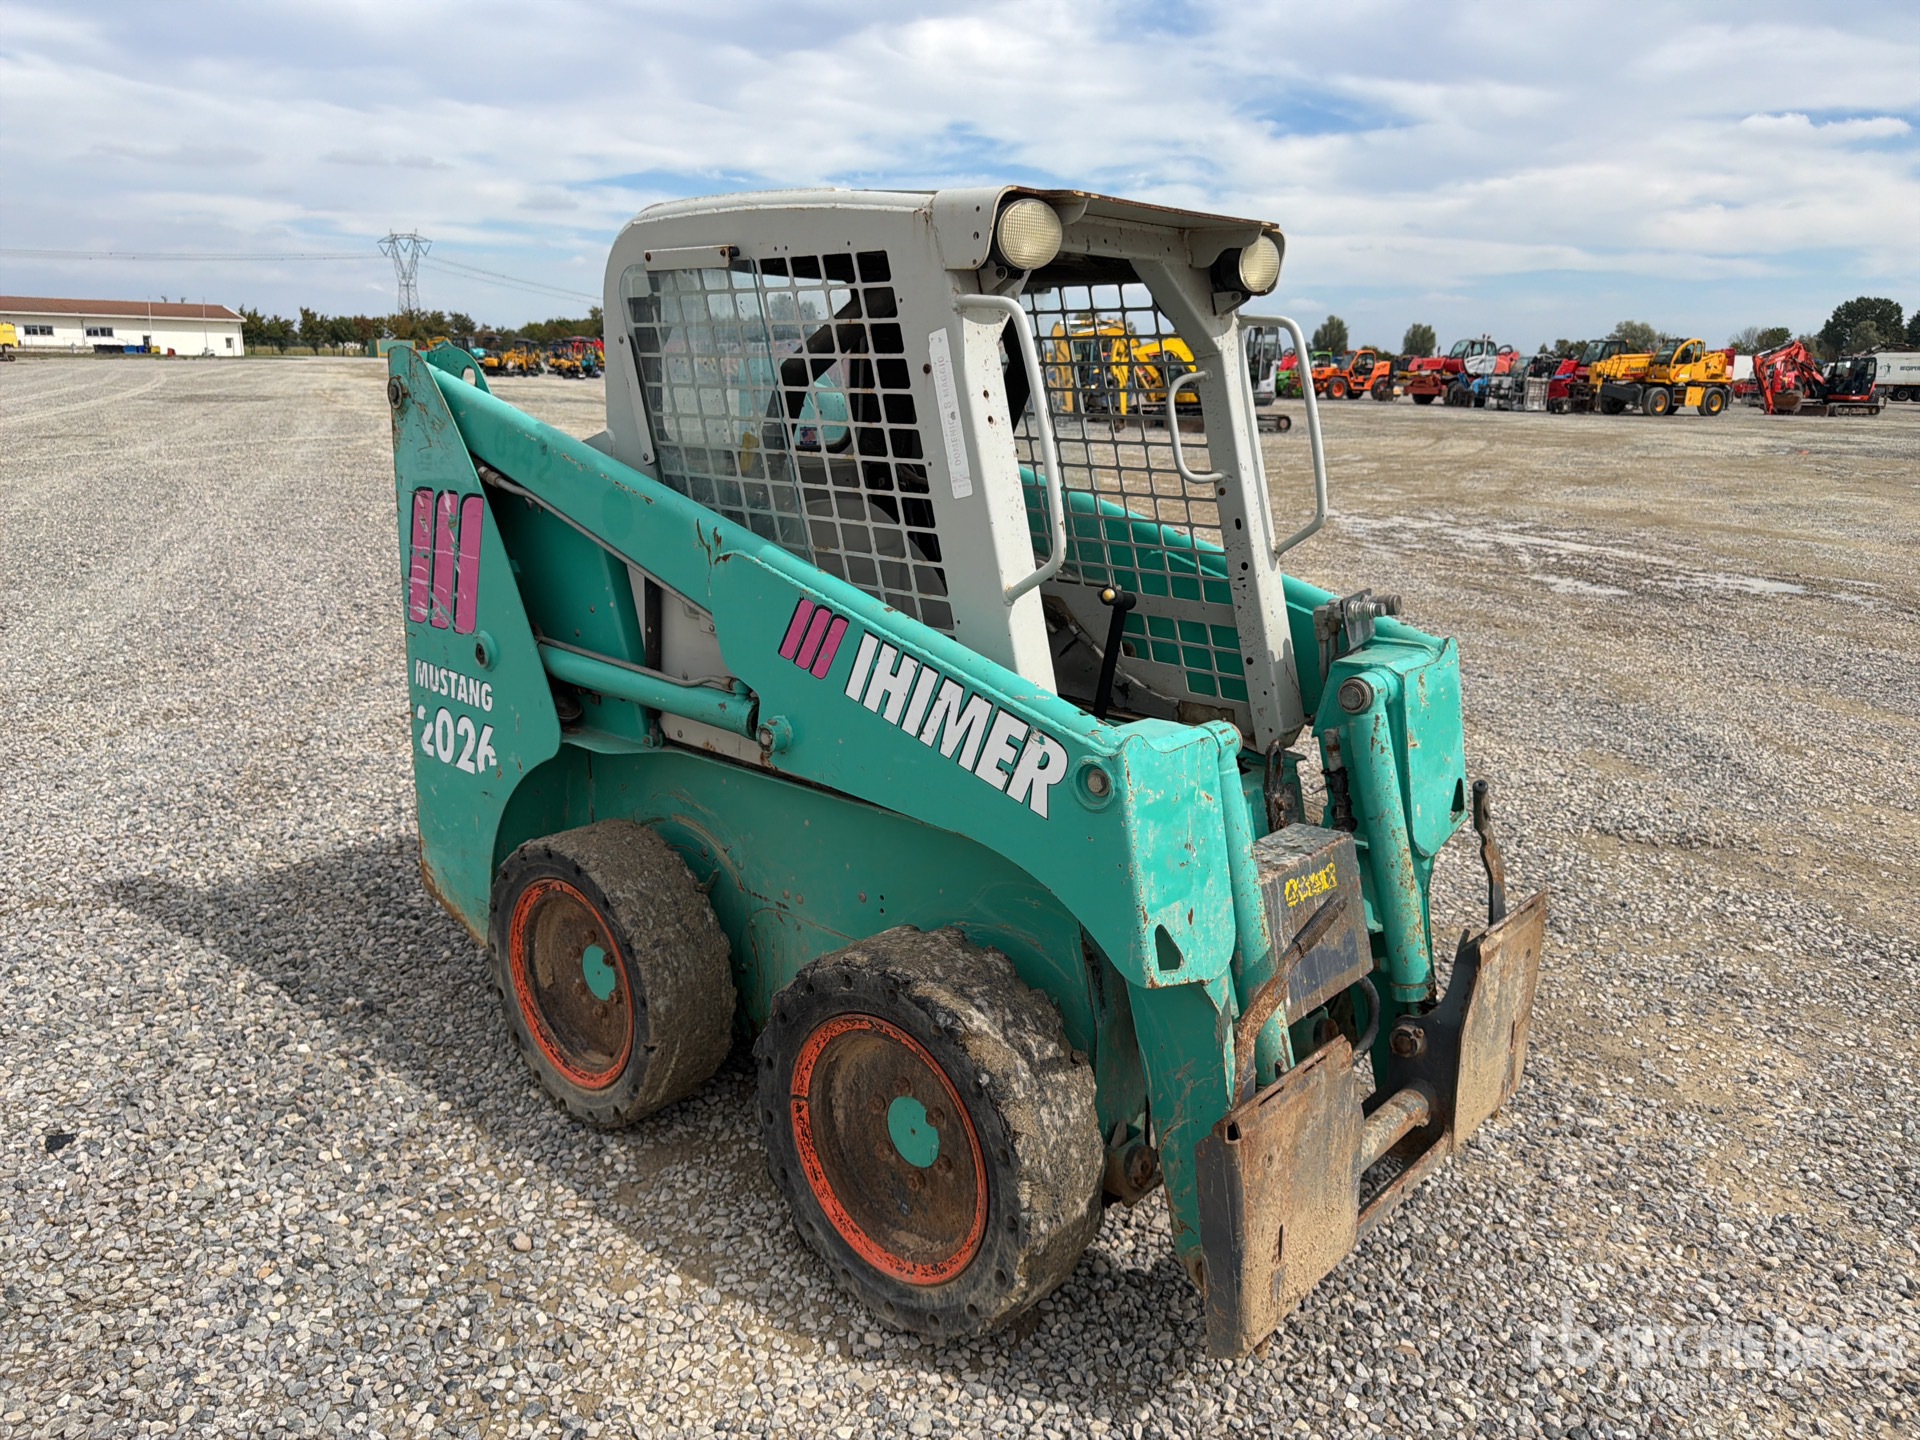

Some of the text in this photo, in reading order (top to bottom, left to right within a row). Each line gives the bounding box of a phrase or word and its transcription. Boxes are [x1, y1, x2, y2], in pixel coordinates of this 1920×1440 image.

[937, 356, 951, 398] MAGGIO
[943, 400, 953, 410] 8
[415, 658, 493, 713] MUSTANG
[416, 704, 498, 775] 2026
[845, 630, 1069, 820] IHIMER
